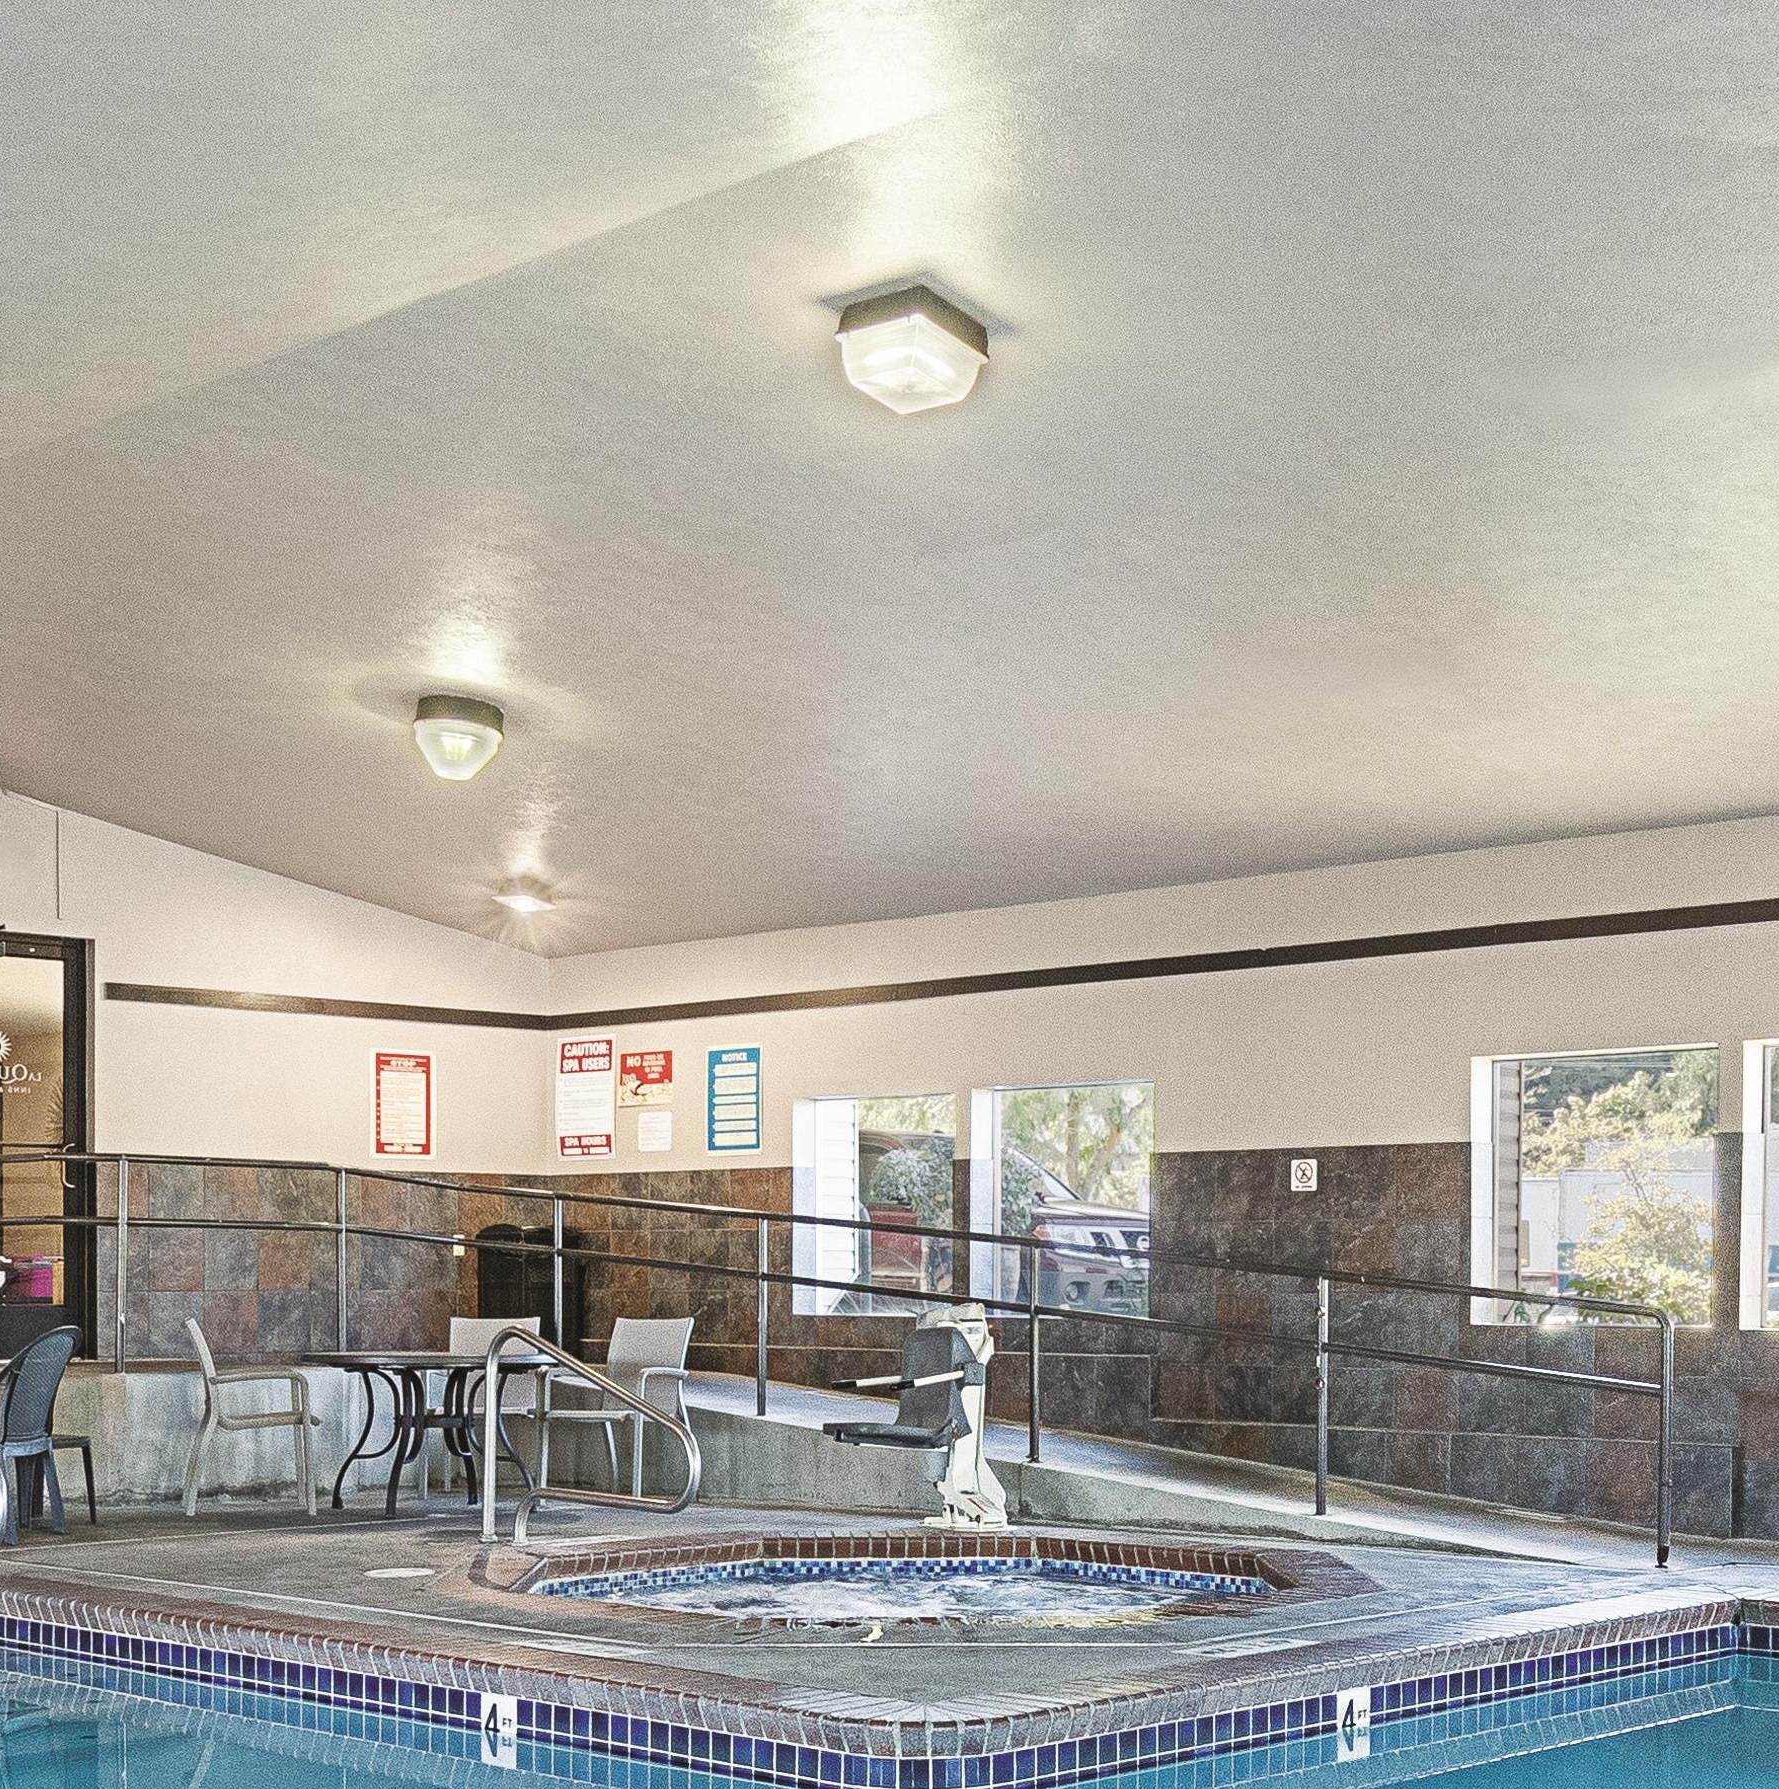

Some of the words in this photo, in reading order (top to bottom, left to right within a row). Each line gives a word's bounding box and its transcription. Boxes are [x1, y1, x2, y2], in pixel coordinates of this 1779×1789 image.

[563, 1042, 610, 1058] CAUTION:
[562, 1058, 580, 1073] SPA
[581, 1056, 611, 1071] USERS
[626, 1055, 641, 1068] NO
